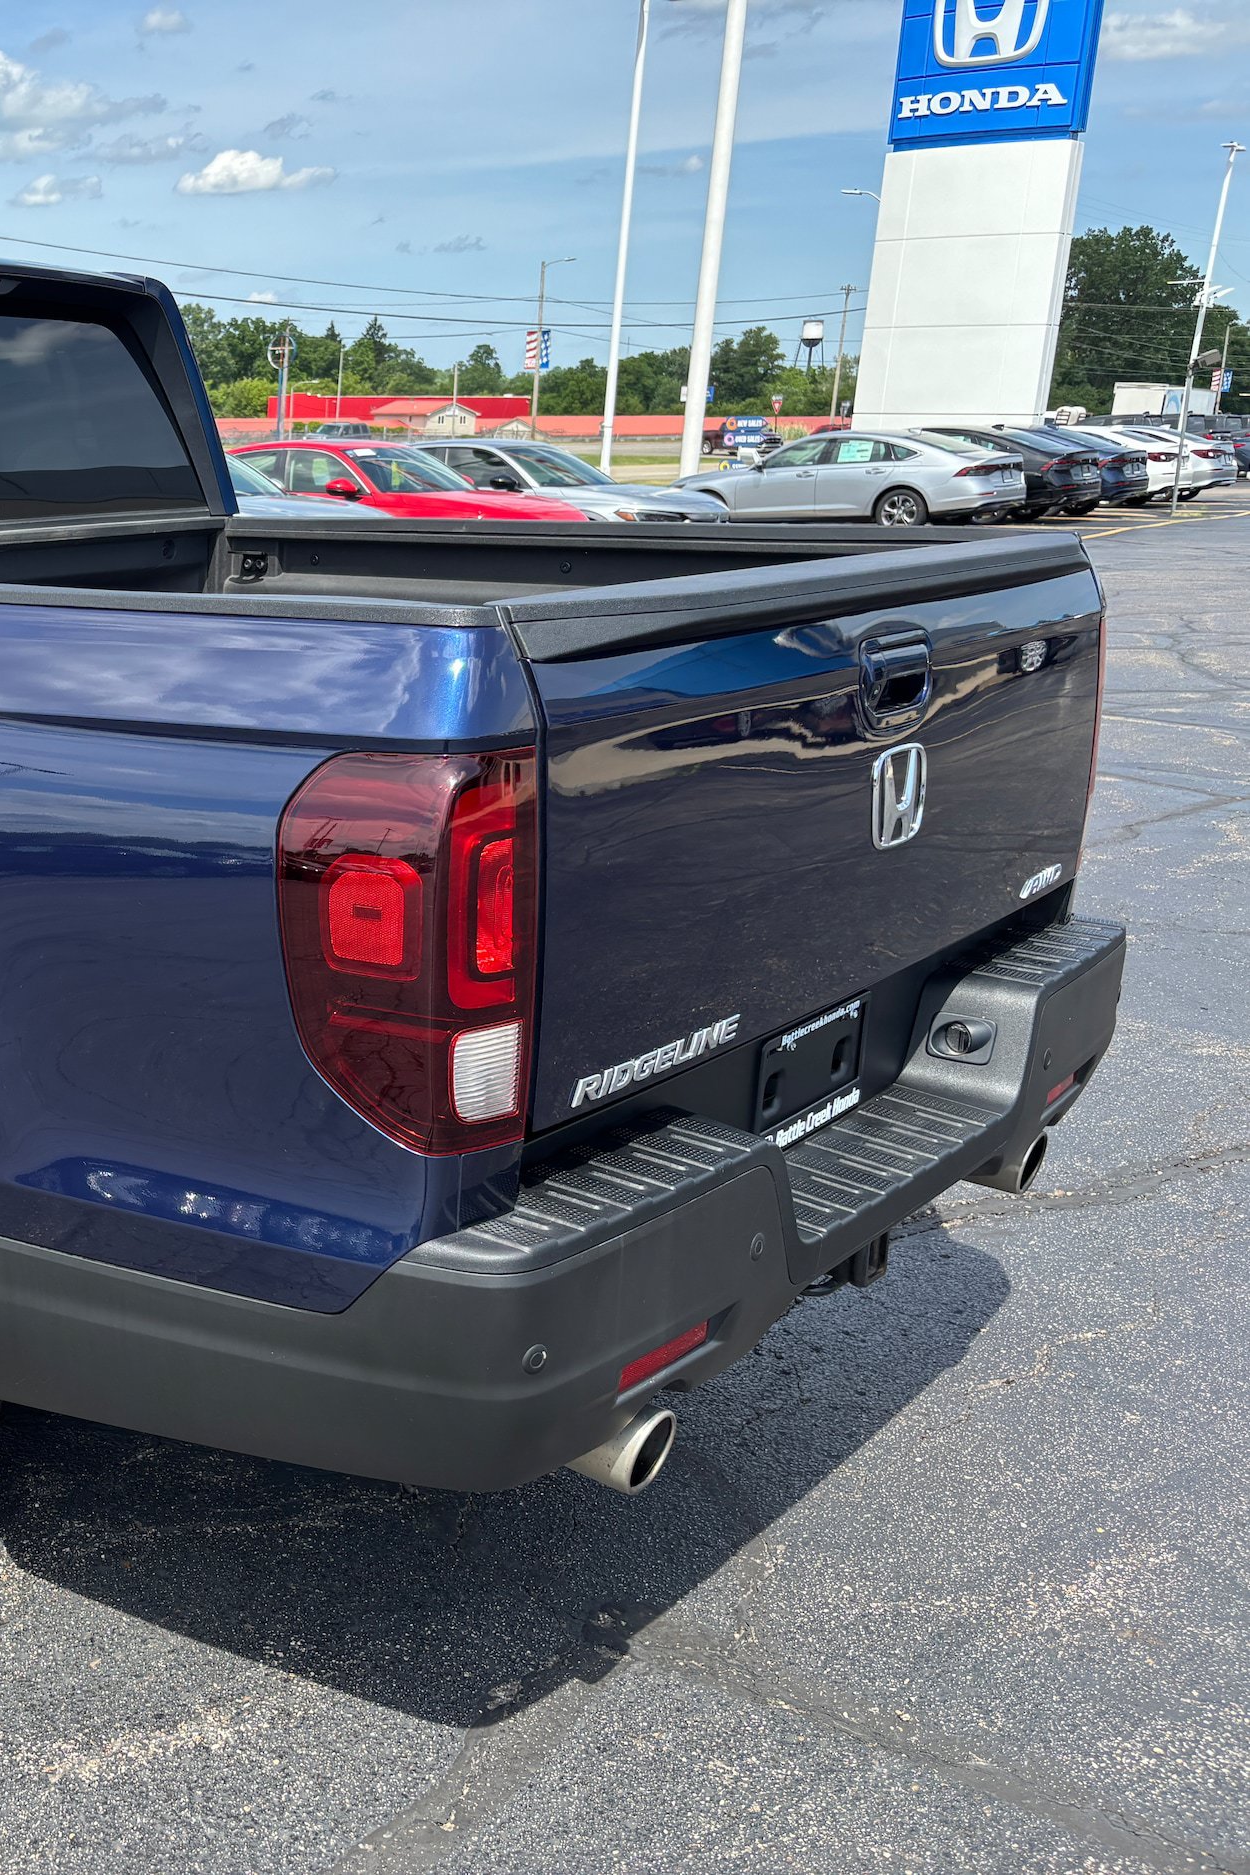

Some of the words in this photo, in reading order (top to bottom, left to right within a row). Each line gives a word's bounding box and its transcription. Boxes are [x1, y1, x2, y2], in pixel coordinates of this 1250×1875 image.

[897, 83, 1068, 119] HONDA
[570, 1013, 741, 1109] RIDGELINE
[775, 1119, 806, 1148] Battle
[805, 1102, 833, 1132] Creek
[831, 1087, 861, 1118] Honda
